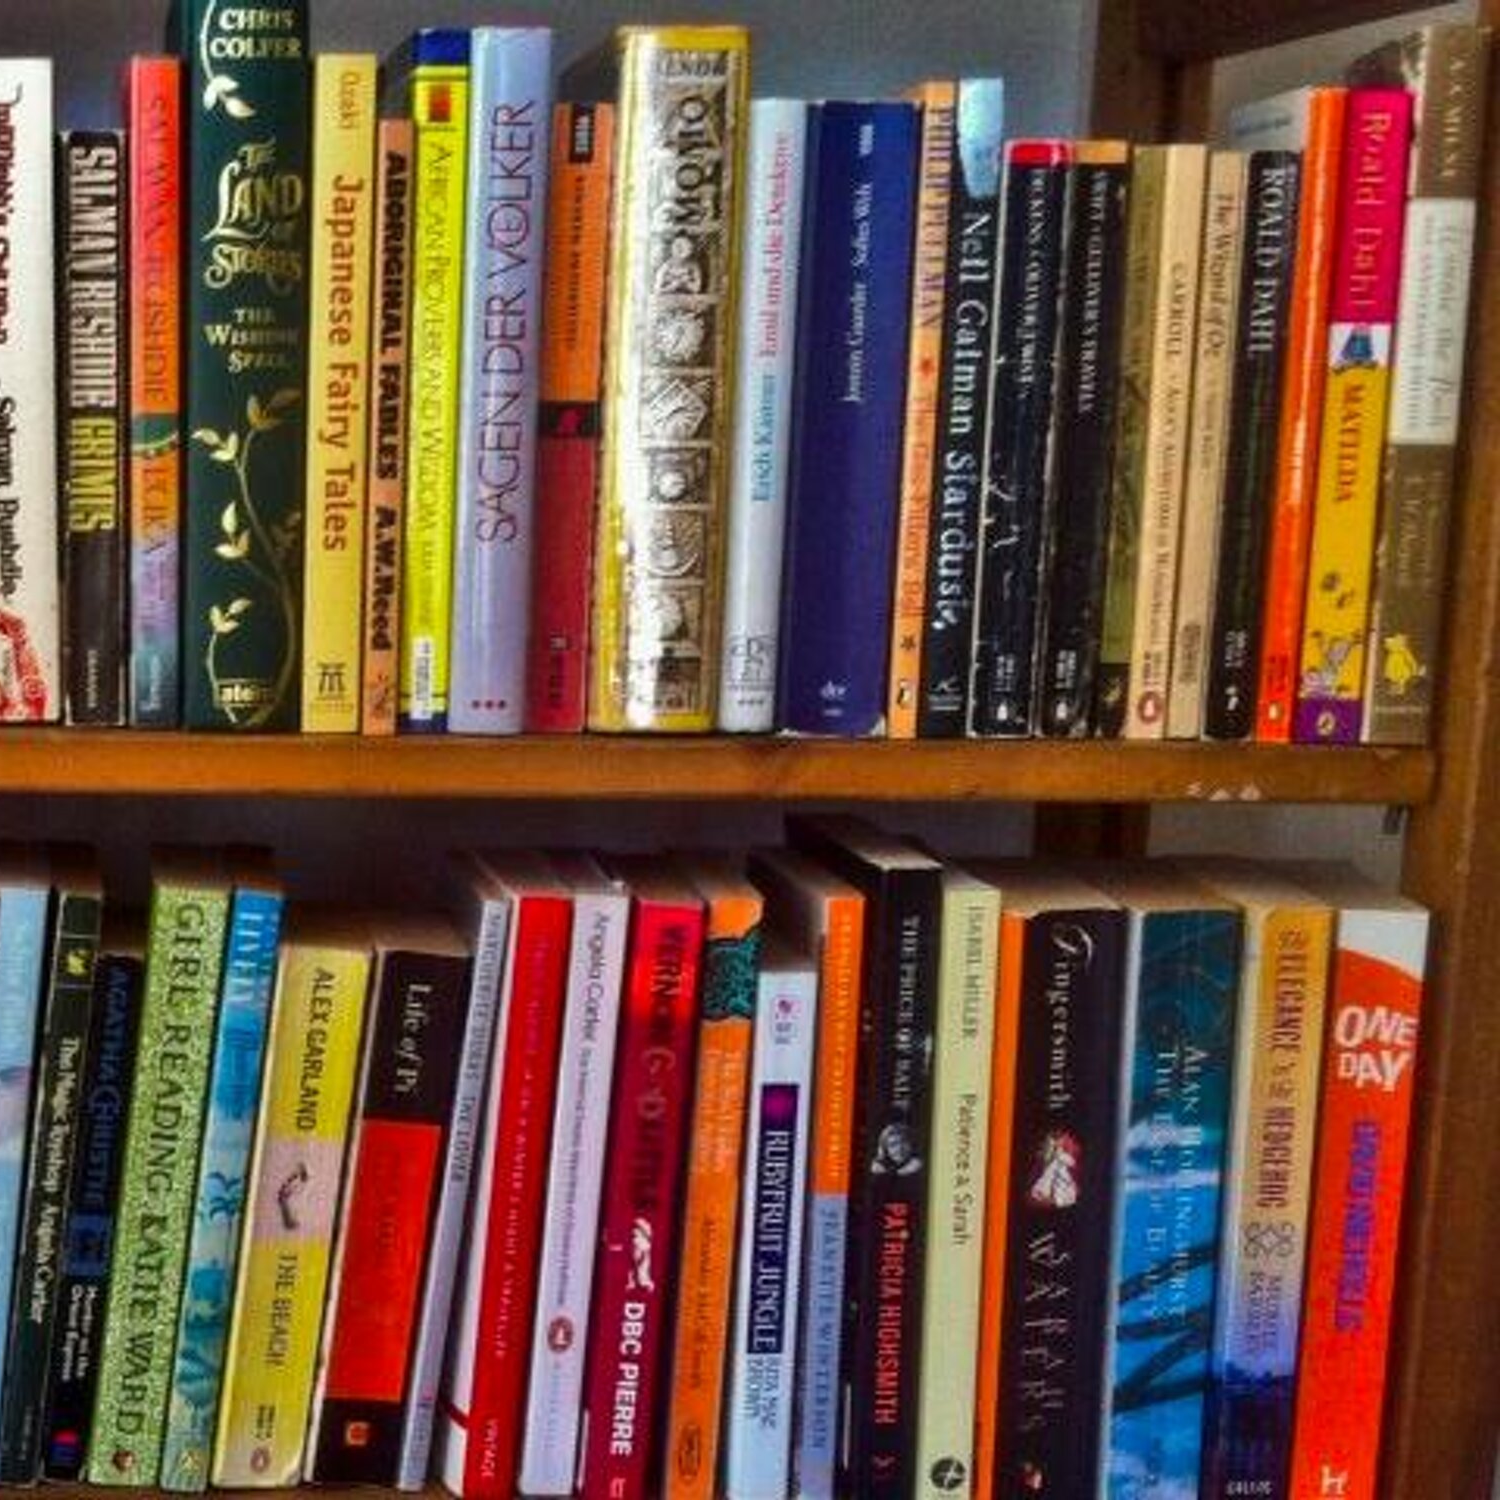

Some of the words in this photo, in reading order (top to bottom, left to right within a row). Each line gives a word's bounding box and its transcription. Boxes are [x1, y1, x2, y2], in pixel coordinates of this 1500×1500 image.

[209, 37, 302, 59] COLFER
[217, 9, 299, 31] CHRIS
[337, 71, 361, 132] Ozaki
[142, 95, 168, 254] SALMAN
[428, 140, 453, 254] AFRICAN
[1350, 109, 1395, 208] Roald
[69, 146, 118, 273] SALMAN
[956, 211, 991, 285] Neil
[1216, 192, 1234, 225] The
[1254, 166, 1286, 268] ROALD
[327, 174, 364, 346] Japanese
[379, 149, 409, 355] ABORIGINAL
[1207, 232, 1233, 302] Wizard
[1349, 227, 1385, 308] Dahl
[69, 280, 119, 408] RUSHDIE
[142, 262, 168, 401] RUSHDIE
[483, 284, 525, 375] DER
[1164, 261, 1189, 359] CARROLL
[1248, 278, 1278, 358] DAHL
[319, 360, 359, 449] Fairy
[420, 370, 447, 422] AND
[949, 299, 989, 434] Gaiman
[375, 360, 403, 480] FABLES
[1333, 381, 1368, 505] MATILDA
[69, 417, 118, 533] GRIMUS
[324, 460, 356, 552] Tales
[474, 391, 523, 544] SAGEN
[935, 448, 978, 618] Stardust
[164, 904, 205, 1004] GIRL
[586, 913, 611, 980] Angela
[902, 914, 923, 957] THE
[963, 905, 987, 970] ISABEL
[97, 966, 130, 1081] AGATHA
[309, 969, 336, 1024] ALEX
[402, 982, 432, 1027] Life
[582, 981, 605, 1043] Carter
[959, 974, 982, 1040] MILLER
[1045, 925, 1095, 1112] Fingersmith
[1333, 1005, 1419, 1049] ONE
[58, 1036, 81, 1069] The
[295, 1027, 328, 1132] GARLAND
[394, 1068, 418, 1094] Pi
[398, 1037, 422, 1063] of
[1180, 1045, 1209, 1113] ALAN
[1337, 1051, 1412, 1093] DAY
[52, 1071, 78, 1121] Magic
[146, 1025, 194, 1194] READING
[954, 1093, 979, 1171] Patience
[42, 1124, 70, 1194] Toyshop
[759, 1129, 792, 1255] RUBYFRUIT
[35, 1205, 61, 1265] Angela
[881, 1202, 911, 1297] PATRICIA
[951, 1193, 974, 1246] Sarah
[27, 1267, 53, 1325] Carter
[274, 1255, 299, 1294] THE
[751, 1262, 784, 1351] JUNGLE
[264, 1299, 293, 1367] BEACH
[618, 1301, 649, 1357] DBC
[874, 1303, 902, 1425] HIGHSMITH
[115, 1329, 154, 1444] WARD
[608, 1362, 642, 1458] PIERRE
